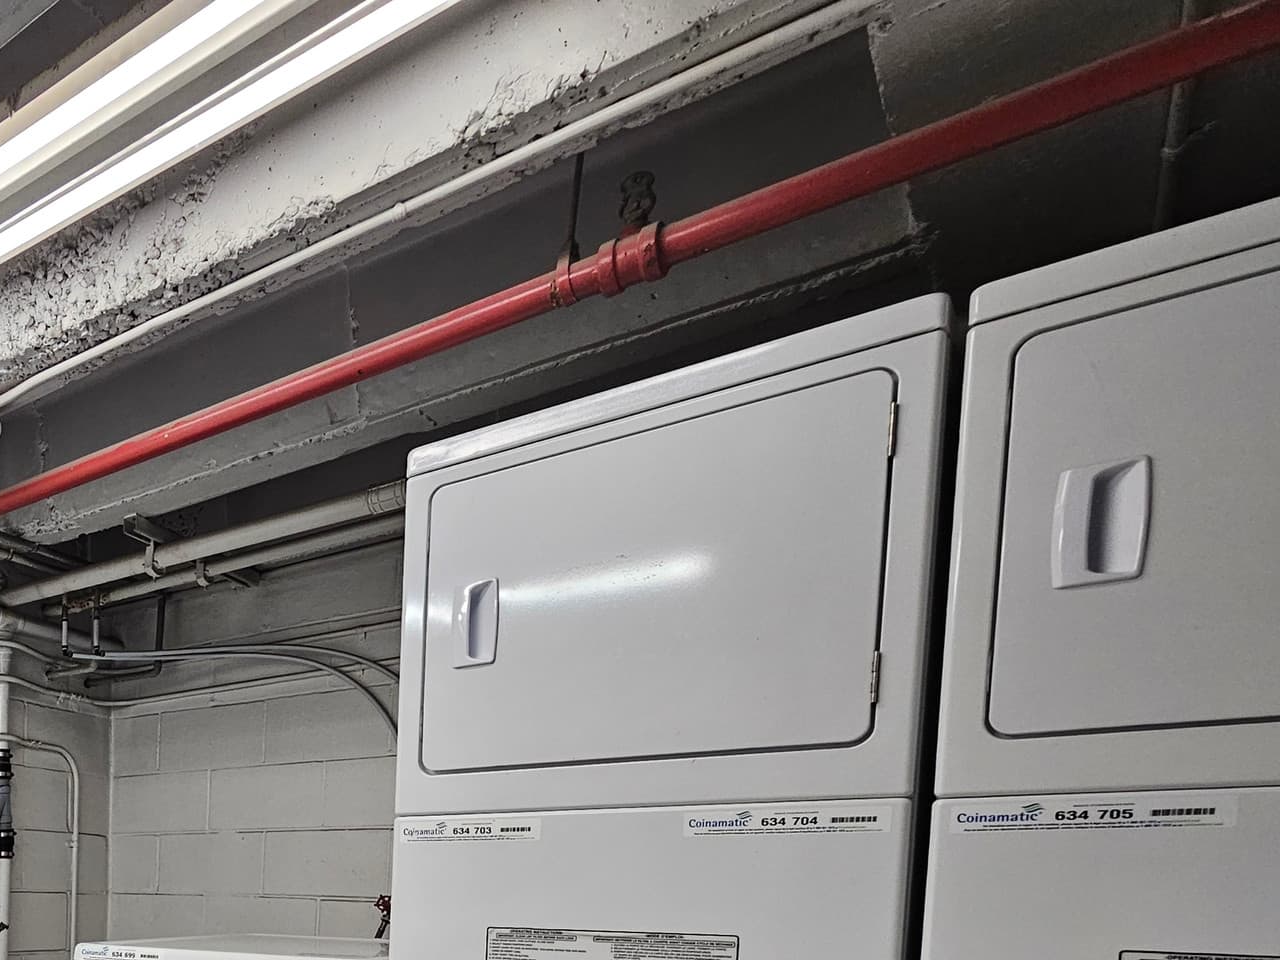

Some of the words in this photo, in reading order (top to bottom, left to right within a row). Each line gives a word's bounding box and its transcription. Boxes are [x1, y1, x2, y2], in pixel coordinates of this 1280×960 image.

[688, 817, 749, 828] Coinamatic
[761, 817, 786, 826] 634
[792, 816, 818, 825] 704
[957, 811, 1039, 824] Coinamatic
[1055, 810, 1089, 821] 634
[1097, 809, 1134, 820] 705
[453, 827, 470, 835] 634
[474, 826, 492, 834] 703
